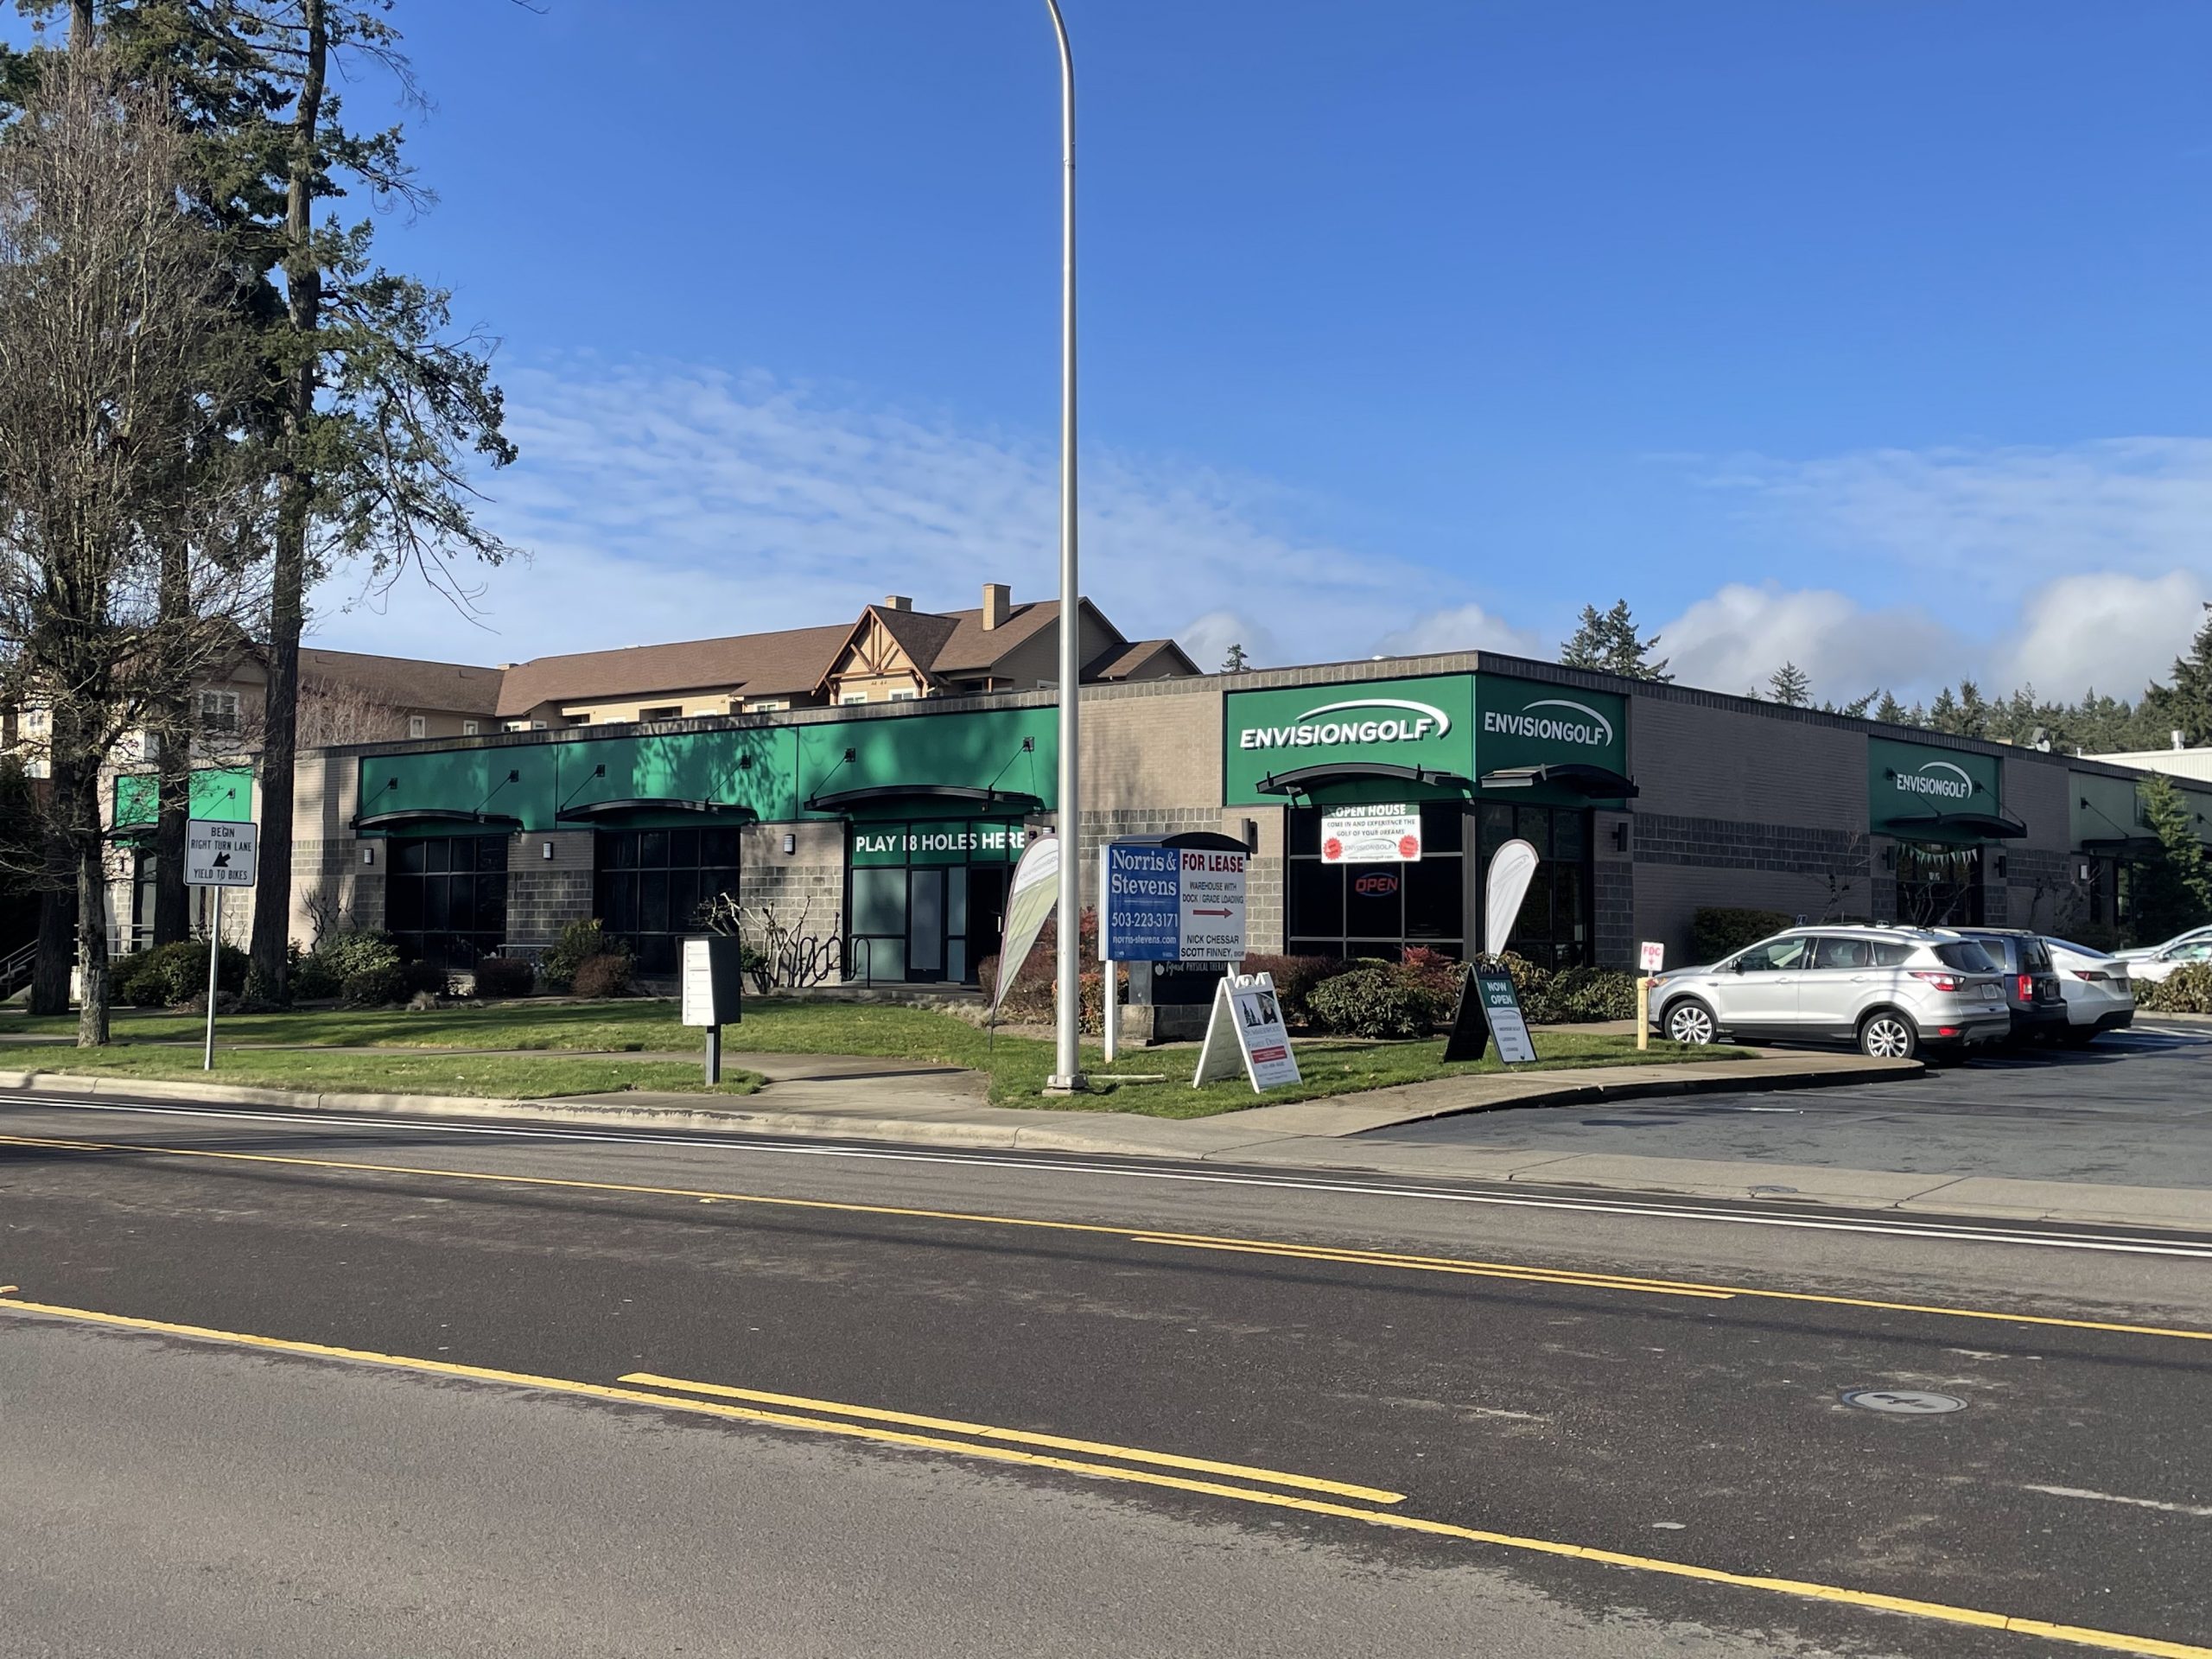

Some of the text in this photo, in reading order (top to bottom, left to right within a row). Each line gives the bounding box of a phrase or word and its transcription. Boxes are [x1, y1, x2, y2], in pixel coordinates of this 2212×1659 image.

[1239, 717, 1436, 749] ENVISIONGOLF
[1484, 711, 1605, 747] ENVISIONGOLF
[1897, 772, 1967, 798] ENVISIONGOLF
[1335, 804, 1407, 817] OPEN HOUSE
[1367, 818, 1402, 827] EXPERIENCE
[211, 826, 235, 838] BEGIN
[190, 839, 252, 852] RIGHT TURN LANE
[855, 831, 1025, 853] PLAY 18 HOLES HERE
[1111, 849, 1177, 872] Norris &
[1182, 853, 1244, 874] FOR LEASE
[194, 868, 248, 880] YIELD TO BIKES
[1111, 873, 1177, 896] Stevens
[1190, 881, 1237, 892] WAREHOUSE WITH
[1355, 877, 1398, 893] OPEN
[1182, 893, 1198, 904] DOCK
[1202, 893, 1220, 904] GRADE
[1221, 895, 1244, 905] LOADING
[1111, 912, 1179, 928] 503-223-3171
[1112, 935, 1177, 944] norris-stevens.com
[1186, 934, 1240, 944] NICK CHESSAR
[1180, 947, 1205, 957] SCOTT
[1205, 948, 1233, 959] FINNEY,
[1643, 946, 1662, 957] FDC
[1486, 982, 1508, 992] NOW
[1491, 995, 1513, 1005] OPEN
